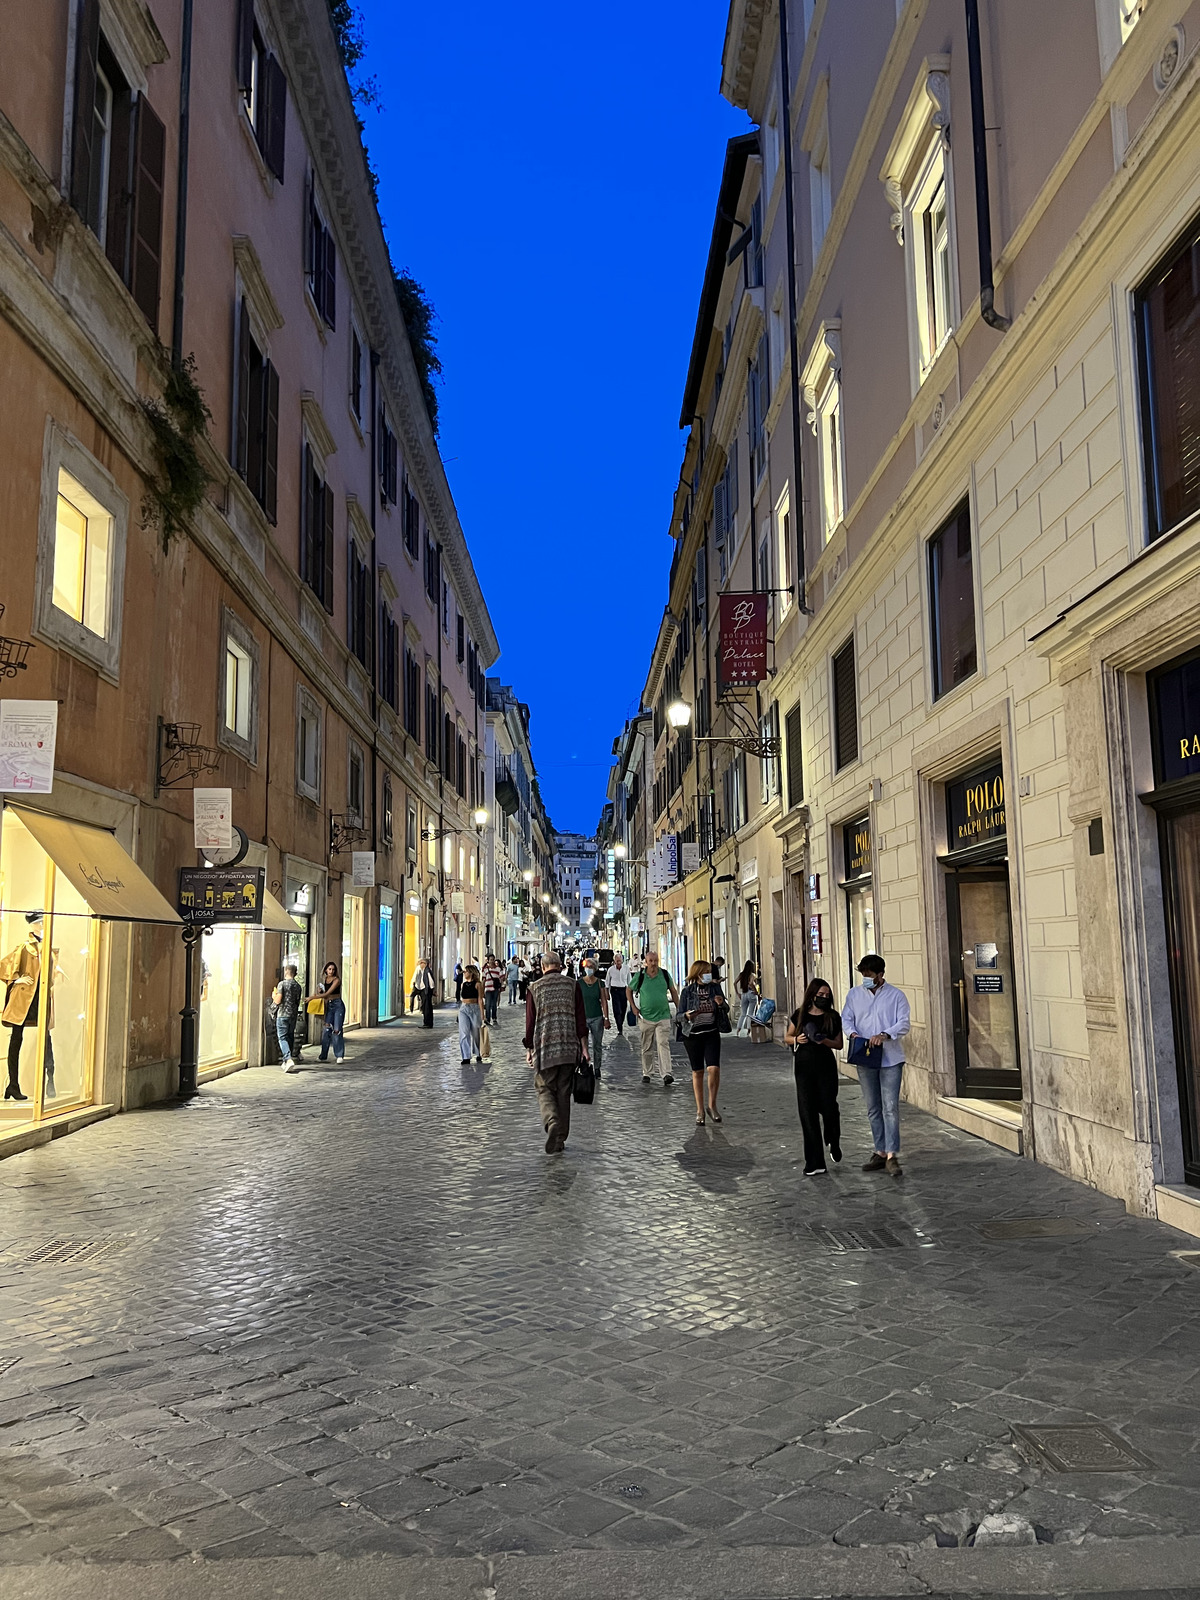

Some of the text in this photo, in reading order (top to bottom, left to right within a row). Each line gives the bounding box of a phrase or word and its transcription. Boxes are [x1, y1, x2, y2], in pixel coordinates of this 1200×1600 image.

[723, 631, 764, 639] BOUTIQUE
[723, 646, 765, 662] Palace
[966, 775, 1003, 817] POLO
[958, 819, 982, 838] RALPH
[855, 830, 870, 855] POL
[667, 836, 677, 877] UnipolSai
